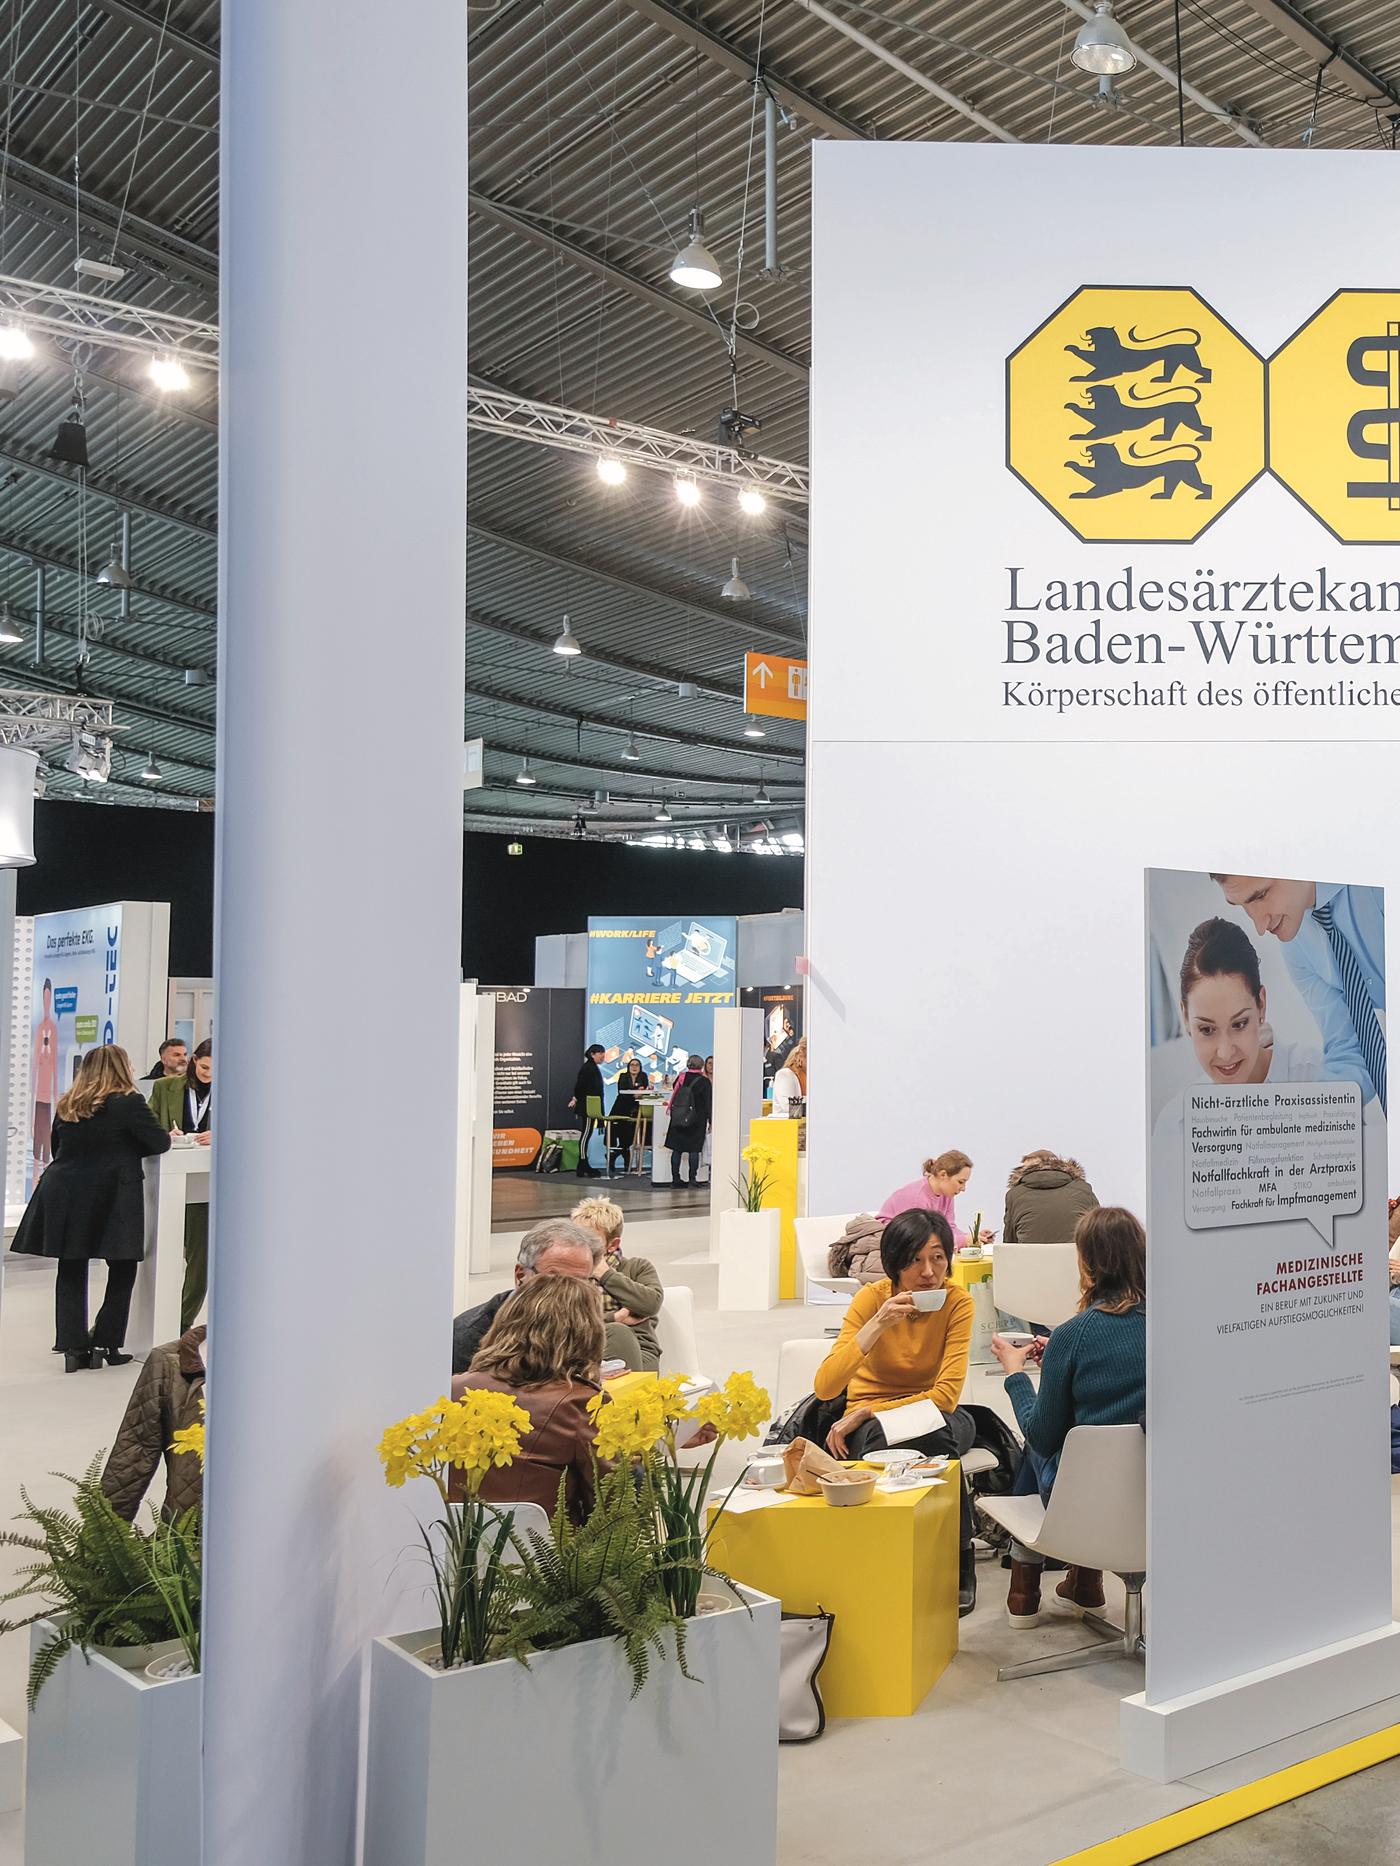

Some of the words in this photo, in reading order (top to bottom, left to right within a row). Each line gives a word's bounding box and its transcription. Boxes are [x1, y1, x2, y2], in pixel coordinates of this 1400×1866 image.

[1002, 681, 1188, 712] Körperschaft
[1197, 681, 1243, 706] des
[590, 992, 682, 1004] #KARRIERE
[685, 992, 734, 1004] JETZT
[1191, 1095, 1269, 1109] Nicht-ärztliche
[1274, 1093, 1355, 1107] Praxisassistentin
[1191, 1126, 1237, 1139] Fachwirtin
[1241, 1124, 1252, 1136] für
[1256, 1122, 1302, 1135] ambulante
[1305, 1120, 1356, 1133] medizinische
[1191, 1142, 1243, 1155] Versorgung
[1192, 1165, 1270, 1183] Notfallfachkraft
[1275, 1166, 1283, 1177] in
[1289, 1164, 1304, 1176] der
[1309, 1161, 1356, 1176] Arztpraxis
[1258, 1183, 1277, 1193] MFA
[1231, 1199, 1264, 1210] Fachkraft
[1265, 1198, 1275, 1207] für
[1277, 1189, 1357, 1206] Impfmanagement
[1276, 1252, 1363, 1275] MEDIZINISCHE
[1256, 1269, 1363, 1295] FACHANGESTELLTE
[1260, 1303, 1274, 1313] EIN
[1275, 1299, 1298, 1311] BERUF
[1300, 1296, 1312, 1308] MIT
[1313, 1292, 1346, 1306] ZUKUNFT
[1347, 1290, 1364, 1300] UND
